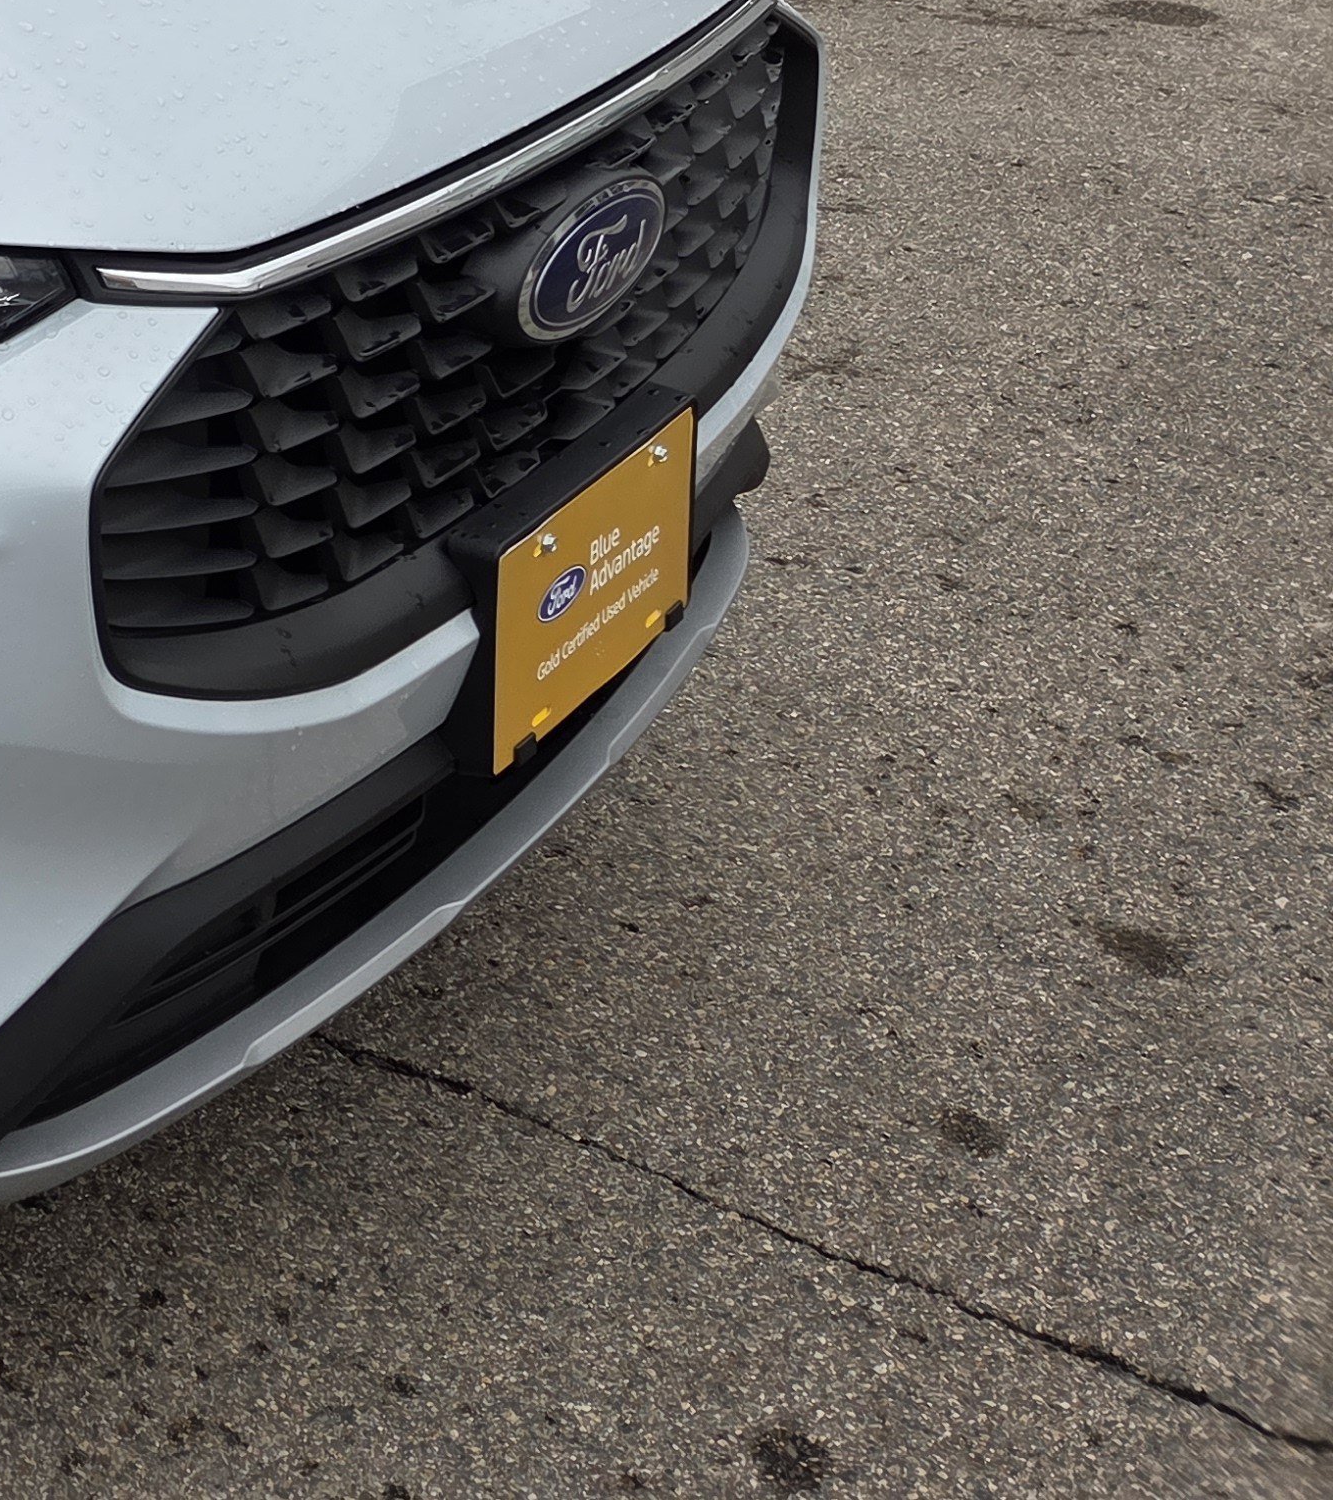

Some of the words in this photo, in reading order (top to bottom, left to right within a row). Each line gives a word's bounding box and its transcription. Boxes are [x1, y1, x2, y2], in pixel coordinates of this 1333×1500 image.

[566, 214, 647, 314] Ford
[589, 527, 621, 566] Blue
[589, 525, 660, 596] Advantage
[537, 648, 560, 681] Gold
[562, 613, 601, 660] Certified
[601, 592, 626, 624] Used
[627, 567, 660, 604] Vehicle
[547, 574, 578, 616] Ford
